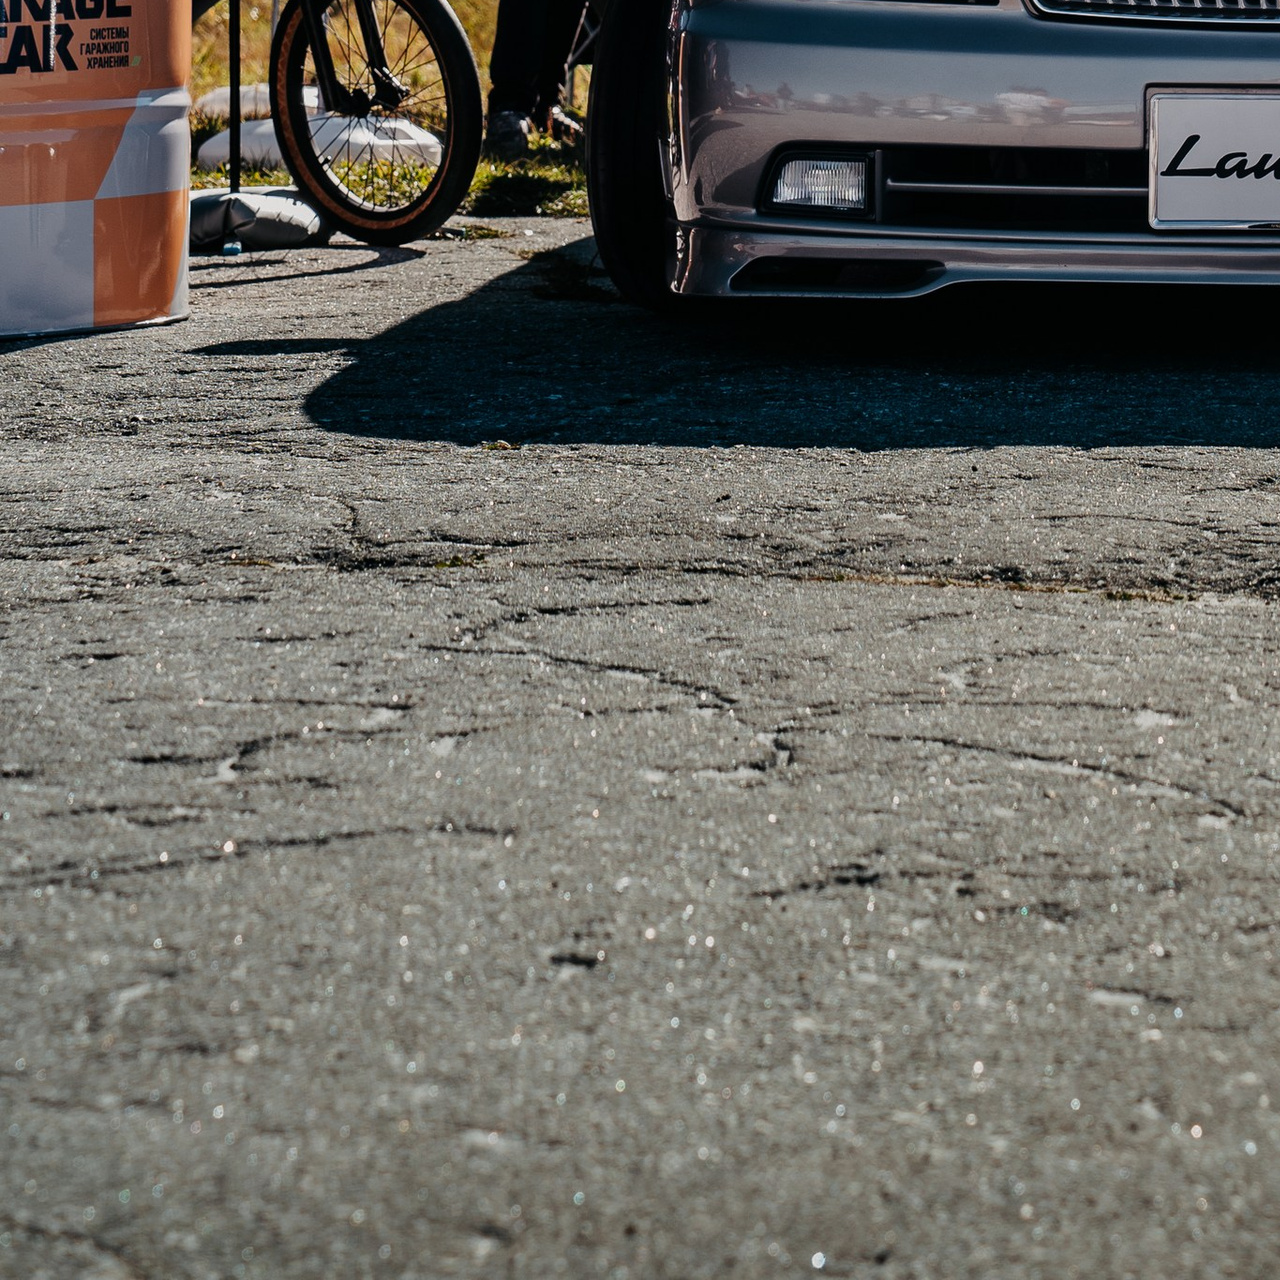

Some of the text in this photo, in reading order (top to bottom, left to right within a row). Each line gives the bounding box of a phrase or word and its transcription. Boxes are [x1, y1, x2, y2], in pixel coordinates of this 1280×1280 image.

[89, 26, 130, 41] СИСТЕМЫ
[0, 23, 79, 74] AR
[80, 40, 130, 56] ГАРАЖНОГО
[86, 55, 130, 70] ХРАНЕНИЯ
